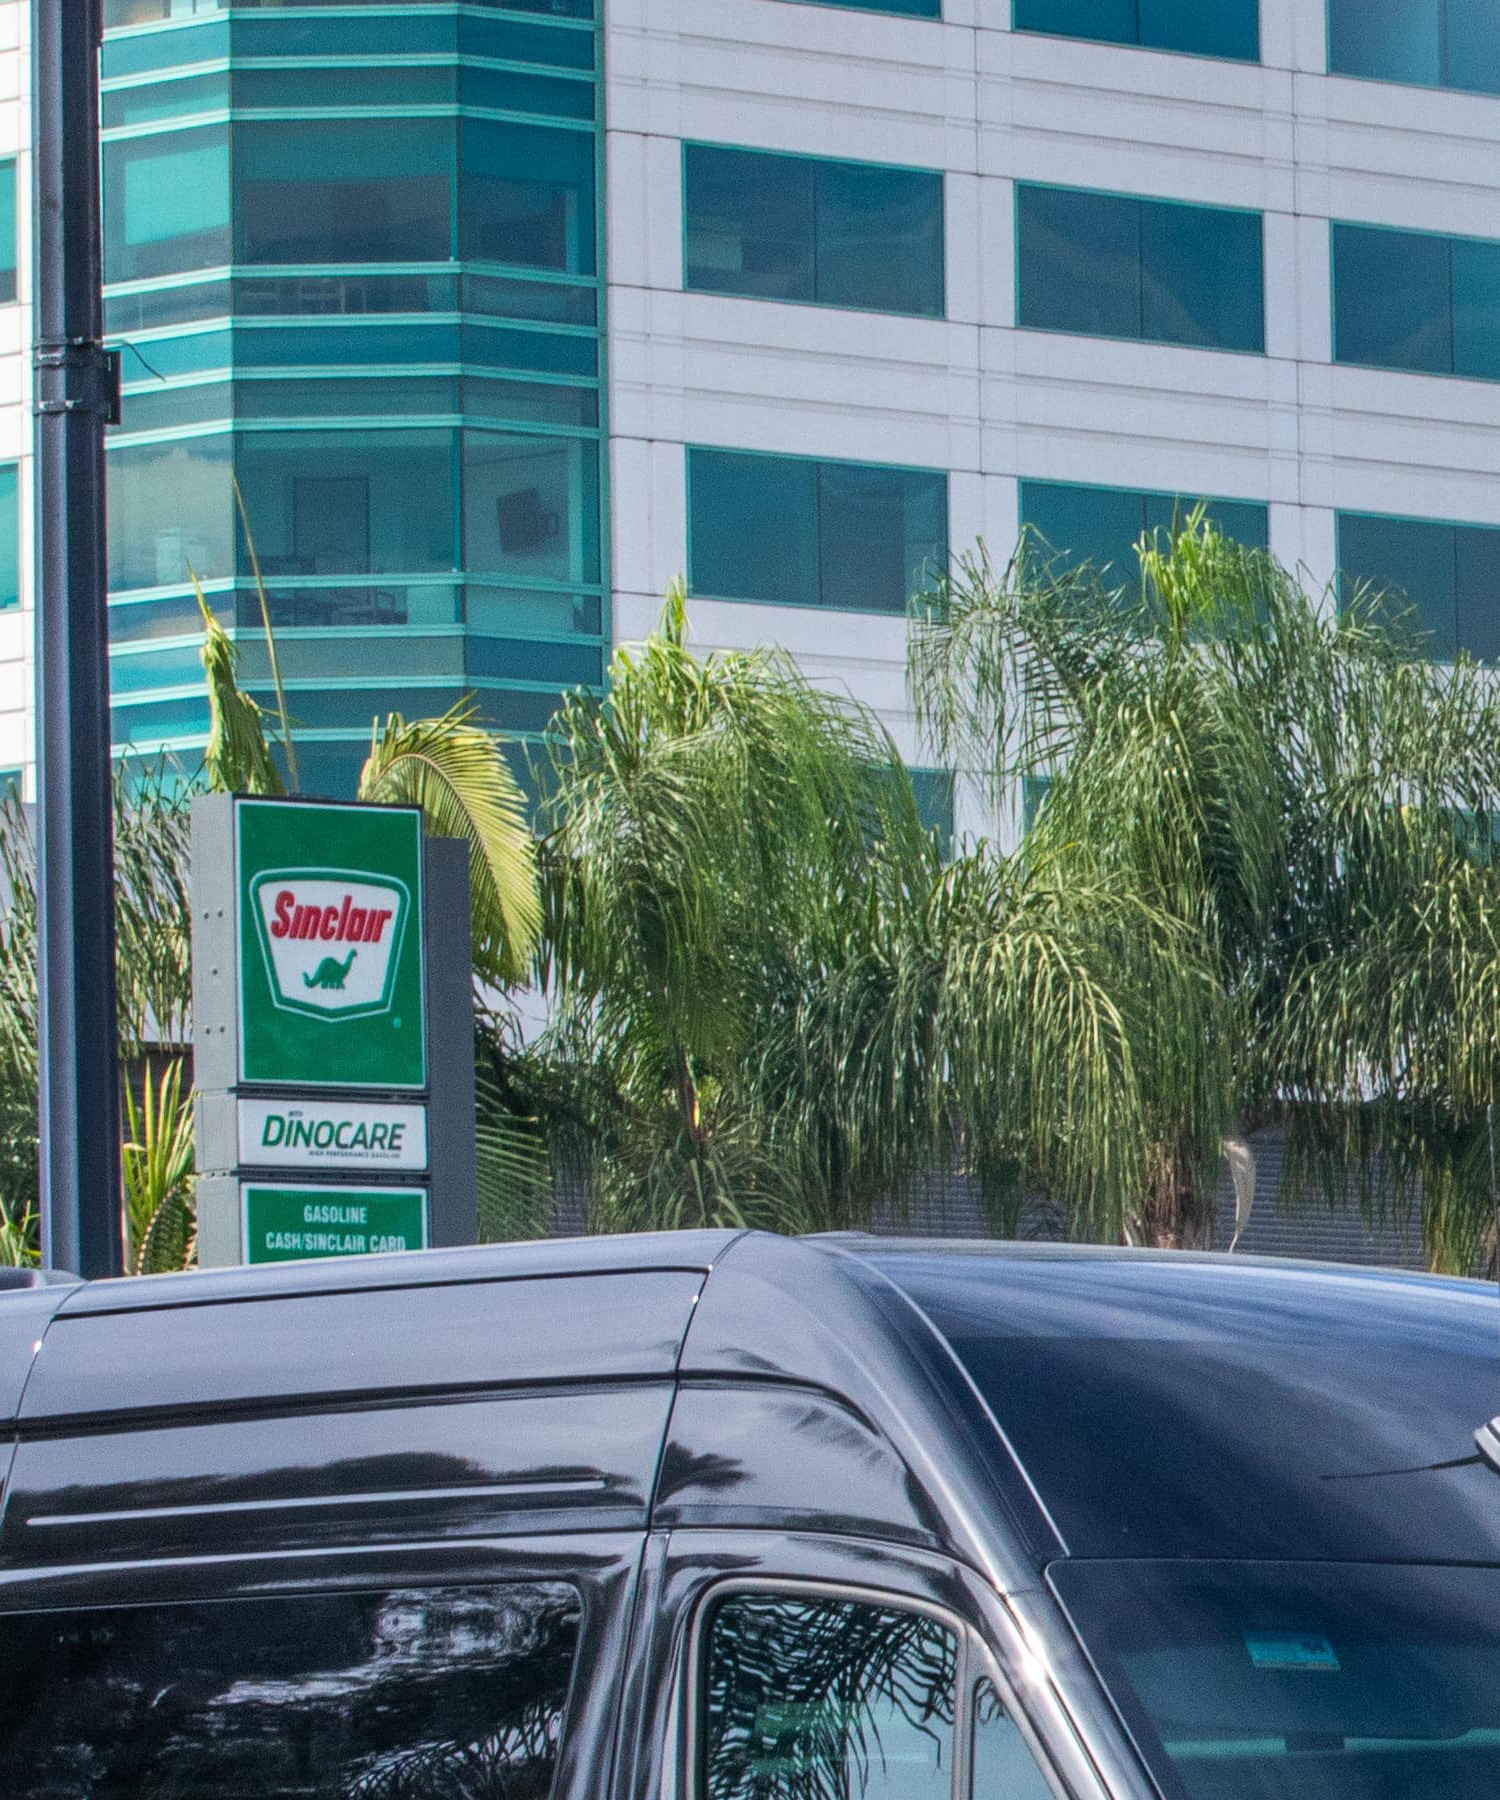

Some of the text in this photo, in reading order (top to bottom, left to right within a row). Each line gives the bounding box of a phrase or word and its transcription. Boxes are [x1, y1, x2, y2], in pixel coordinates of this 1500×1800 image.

[271, 890, 393, 943] Sinclair
[262, 1114, 407, 1151] DINOCARE
[303, 1204, 368, 1225] GASOLINE
[265, 1231, 405, 1253] CASH/SINCLAIR CARD
